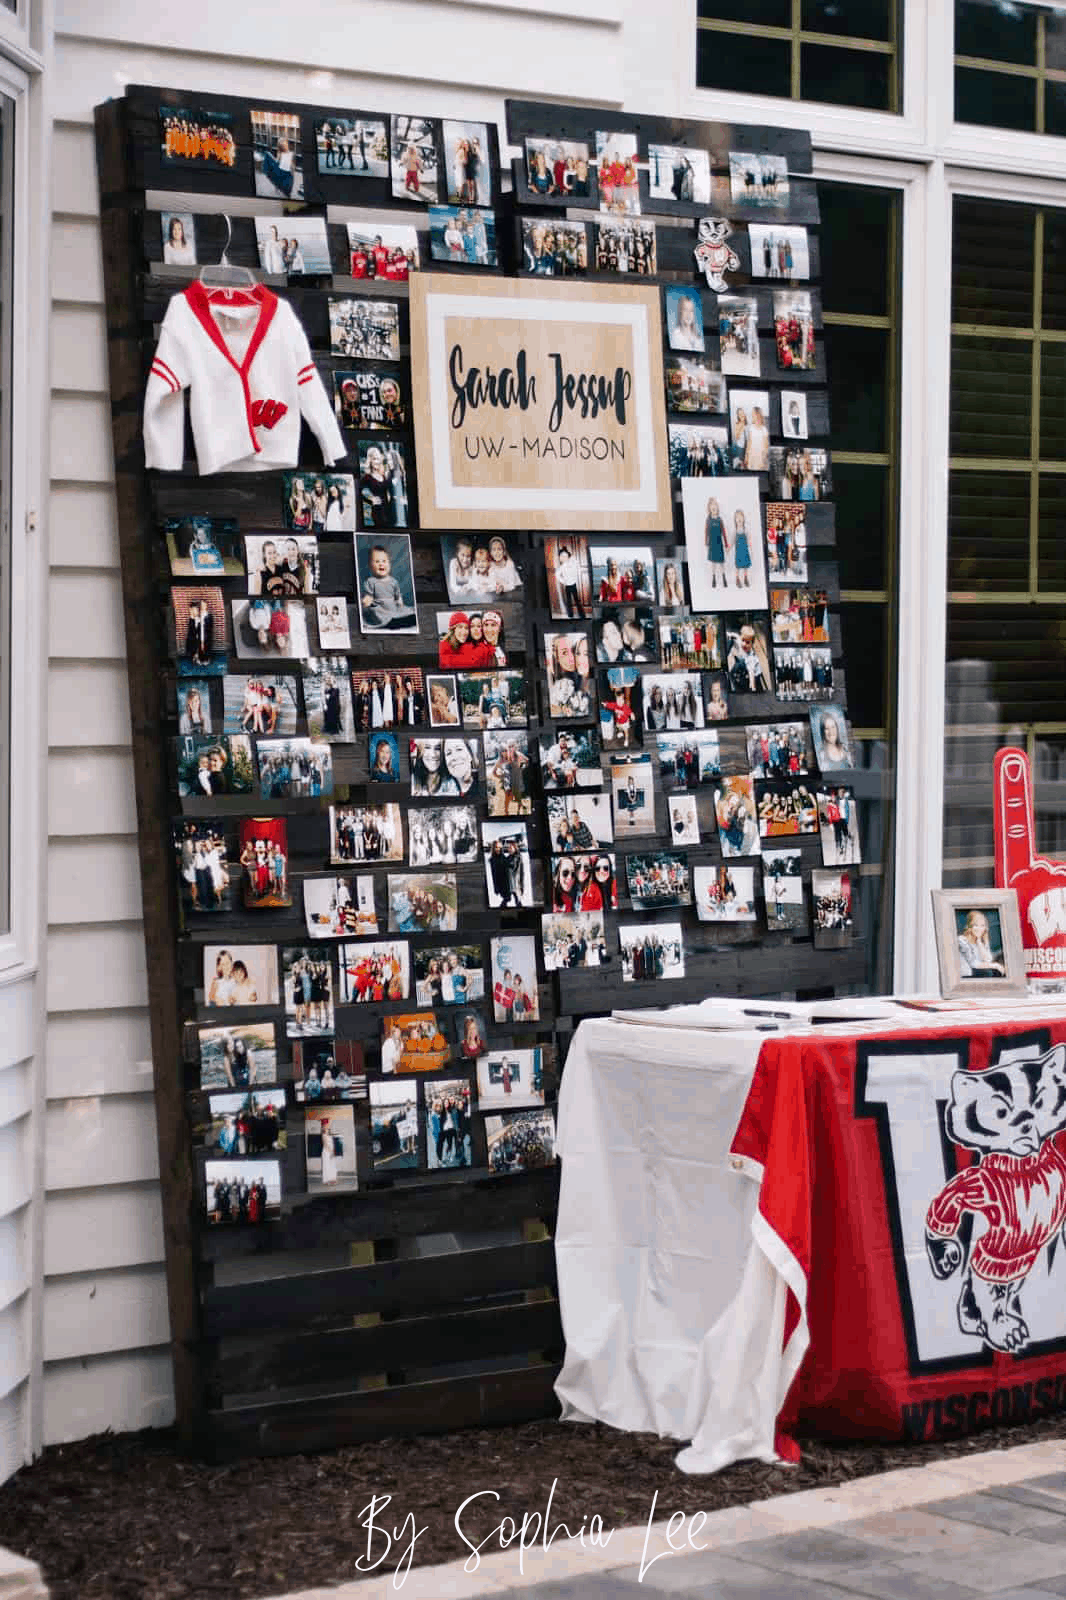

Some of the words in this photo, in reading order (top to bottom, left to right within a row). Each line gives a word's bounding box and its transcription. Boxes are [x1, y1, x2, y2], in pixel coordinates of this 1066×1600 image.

[449, 344, 536, 429] Sarah
[548, 353, 631, 432] Jessup
[465, 436, 625, 460] UW-MADISON
[1024, 947, 1066, 963] WISCO
[902, 1375, 1066, 1438] WISCONSI
